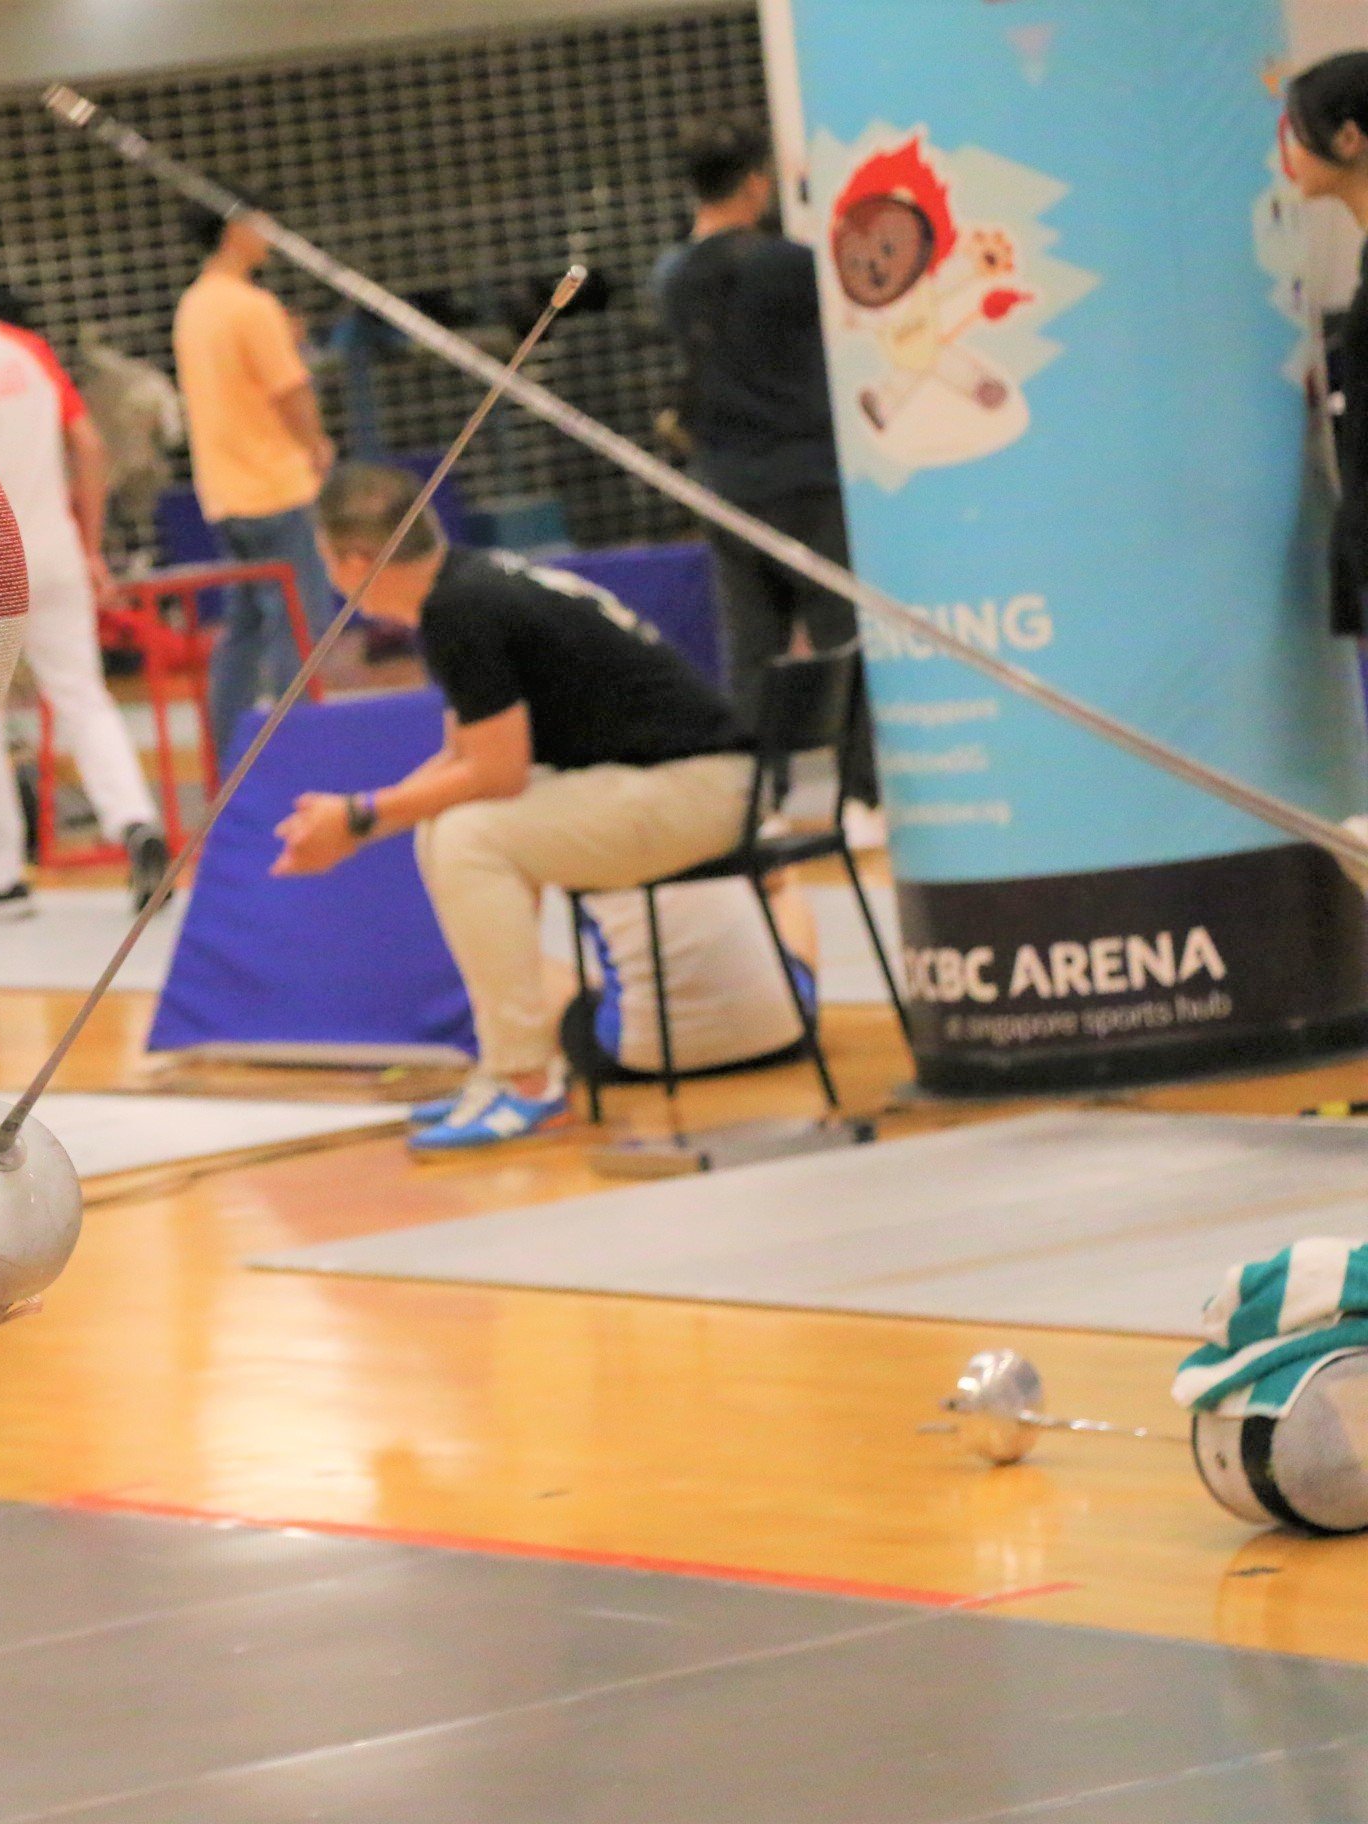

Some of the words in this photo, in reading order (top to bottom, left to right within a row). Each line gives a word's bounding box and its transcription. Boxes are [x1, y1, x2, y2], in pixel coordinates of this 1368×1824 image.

[1009, 924, 1228, 1000] ARENA
[1081, 1001, 1175, 1039] sports
[1175, 990, 1232, 1023] hub
